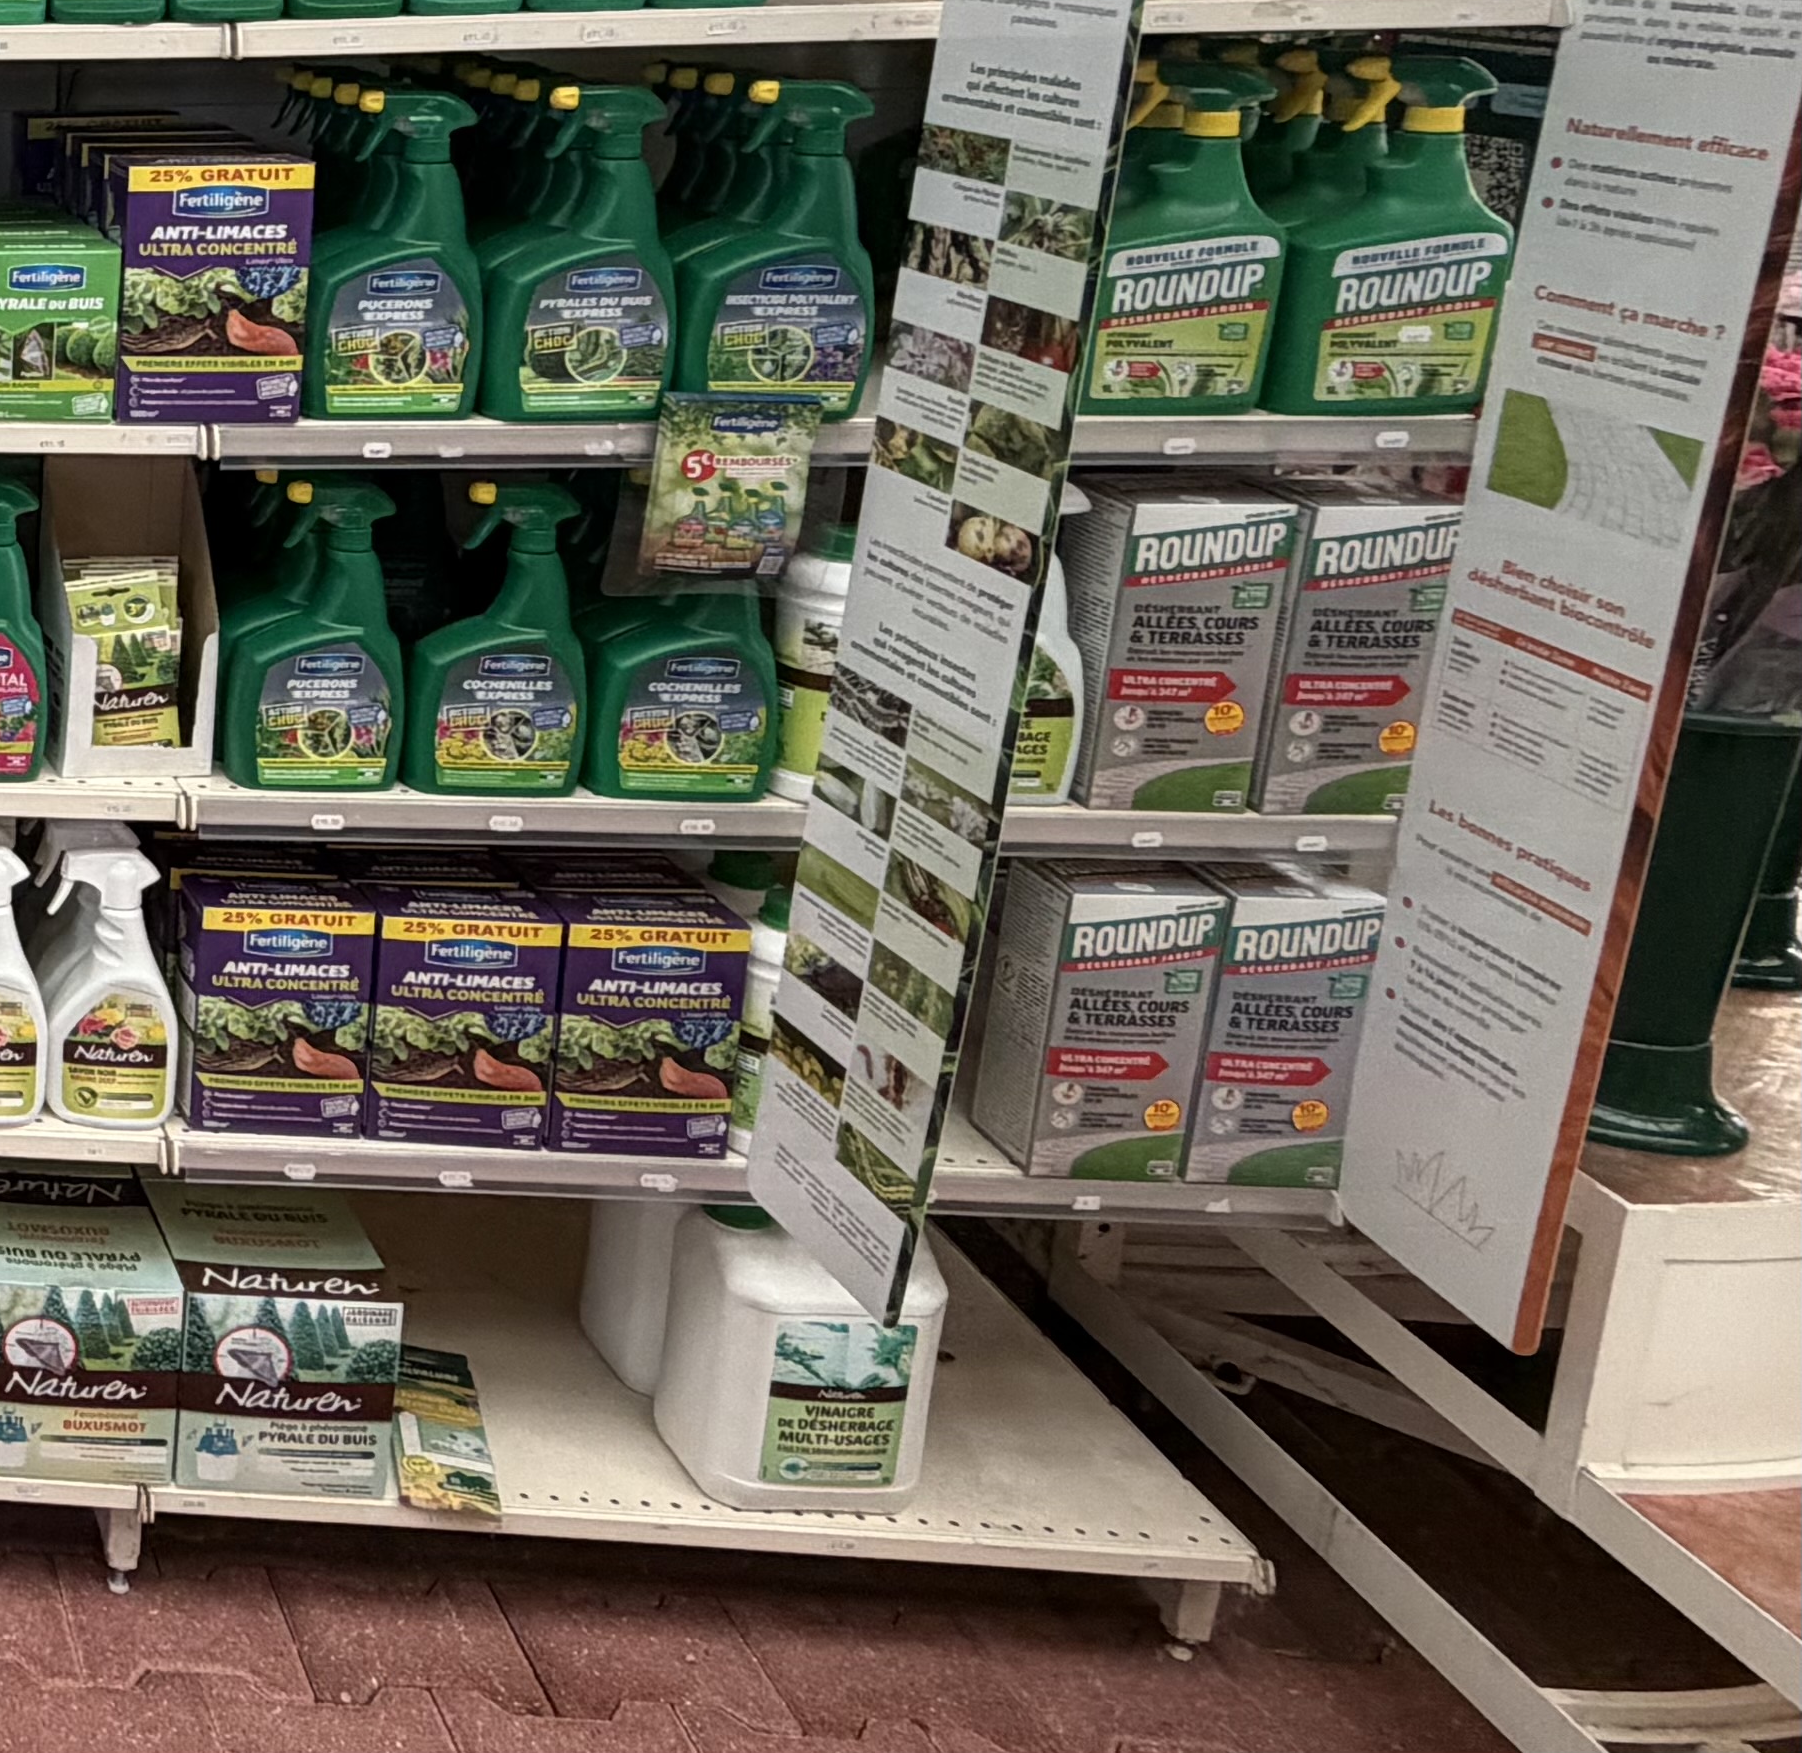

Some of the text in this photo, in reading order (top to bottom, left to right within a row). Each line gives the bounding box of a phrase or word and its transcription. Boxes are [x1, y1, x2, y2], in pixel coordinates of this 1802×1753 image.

[1566, 118, 1769, 162] Naturellement efficace
[149, 167, 295, 183] 25% GRATUIT
[179, 189, 264, 211] Fertiligène
[151, 224, 288, 241] ANTI-LIMACES
[139, 238, 298, 257] ULTRA CONCENTRÉ
[1111, 263, 1266, 314] ROUNDUP
[1335, 262, 1492, 314] ROUNDUP
[68, 297, 104, 309] BUIS
[357, 298, 433, 311] PUCERONS
[1535, 285, 1615, 319] Comment
[1620, 303, 1639, 325] ça
[1643, 308, 1708, 339] marche
[1134, 523, 1287, 574] ROUNDUP
[1502, 561, 1537, 587] Bien
[1595, 592, 1625, 619] son
[1133, 603, 1221, 615] DÉSHERBANT
[1132, 613, 1259, 632] ALLÉES, COURS
[1130, 630, 1245, 646] & TERRASSES
[286, 679, 358, 690] PUCERONS
[462, 680, 553, 691] COCHENILLES
[1429, 800, 1454, 826] Les
[1458, 812, 1513, 856] bonnes
[222, 911, 357, 928] 25% GRATUIT
[403, 921, 544, 939] 25% GRATUIT
[590, 927, 732, 945] 25% GRATUIT
[1072, 914, 1216, 959] ROUNDUP
[1233, 919, 1381, 962] ROUNDUP
[431, 944, 513, 963] Fertiligène
[223, 960, 350, 978] ANTI-LIMACES
[212, 975, 360, 992] ULTRA CONCENTRÉ
[403, 971, 535, 990] ANTI-LIMACES
[589, 979, 723, 996] ANTI-LIMACES
[391, 984, 545, 1004] ULTRA CONCENTRÉ
[576, 992, 731, 1010] ULTRA CONCENTRÉ
[1069, 997, 1190, 1015] ALLÉES, COURS
[1230, 1001, 1354, 1020] ALLÉES, COURS
[1067, 1012, 1176, 1028] & TERRASSES
[1228, 1016, 1340, 1033] & TERRASSES
[74, 1043, 154, 1064] Naturen
[202, 1267, 380, 1297] Naturen
[4, 1370, 148, 1402] Naturen
[215, 1381, 363, 1415] Naturen
[805, 1405, 875, 1419] VINAIGRE
[62, 1418, 148, 1434] BUXUSMOT
[777, 1418, 895, 1432] DE DÉSHERBAGE
[259, 1431, 378, 1447] PYRALE DU BUIS
[778, 1430, 890, 1445] MULTI-USAGES
